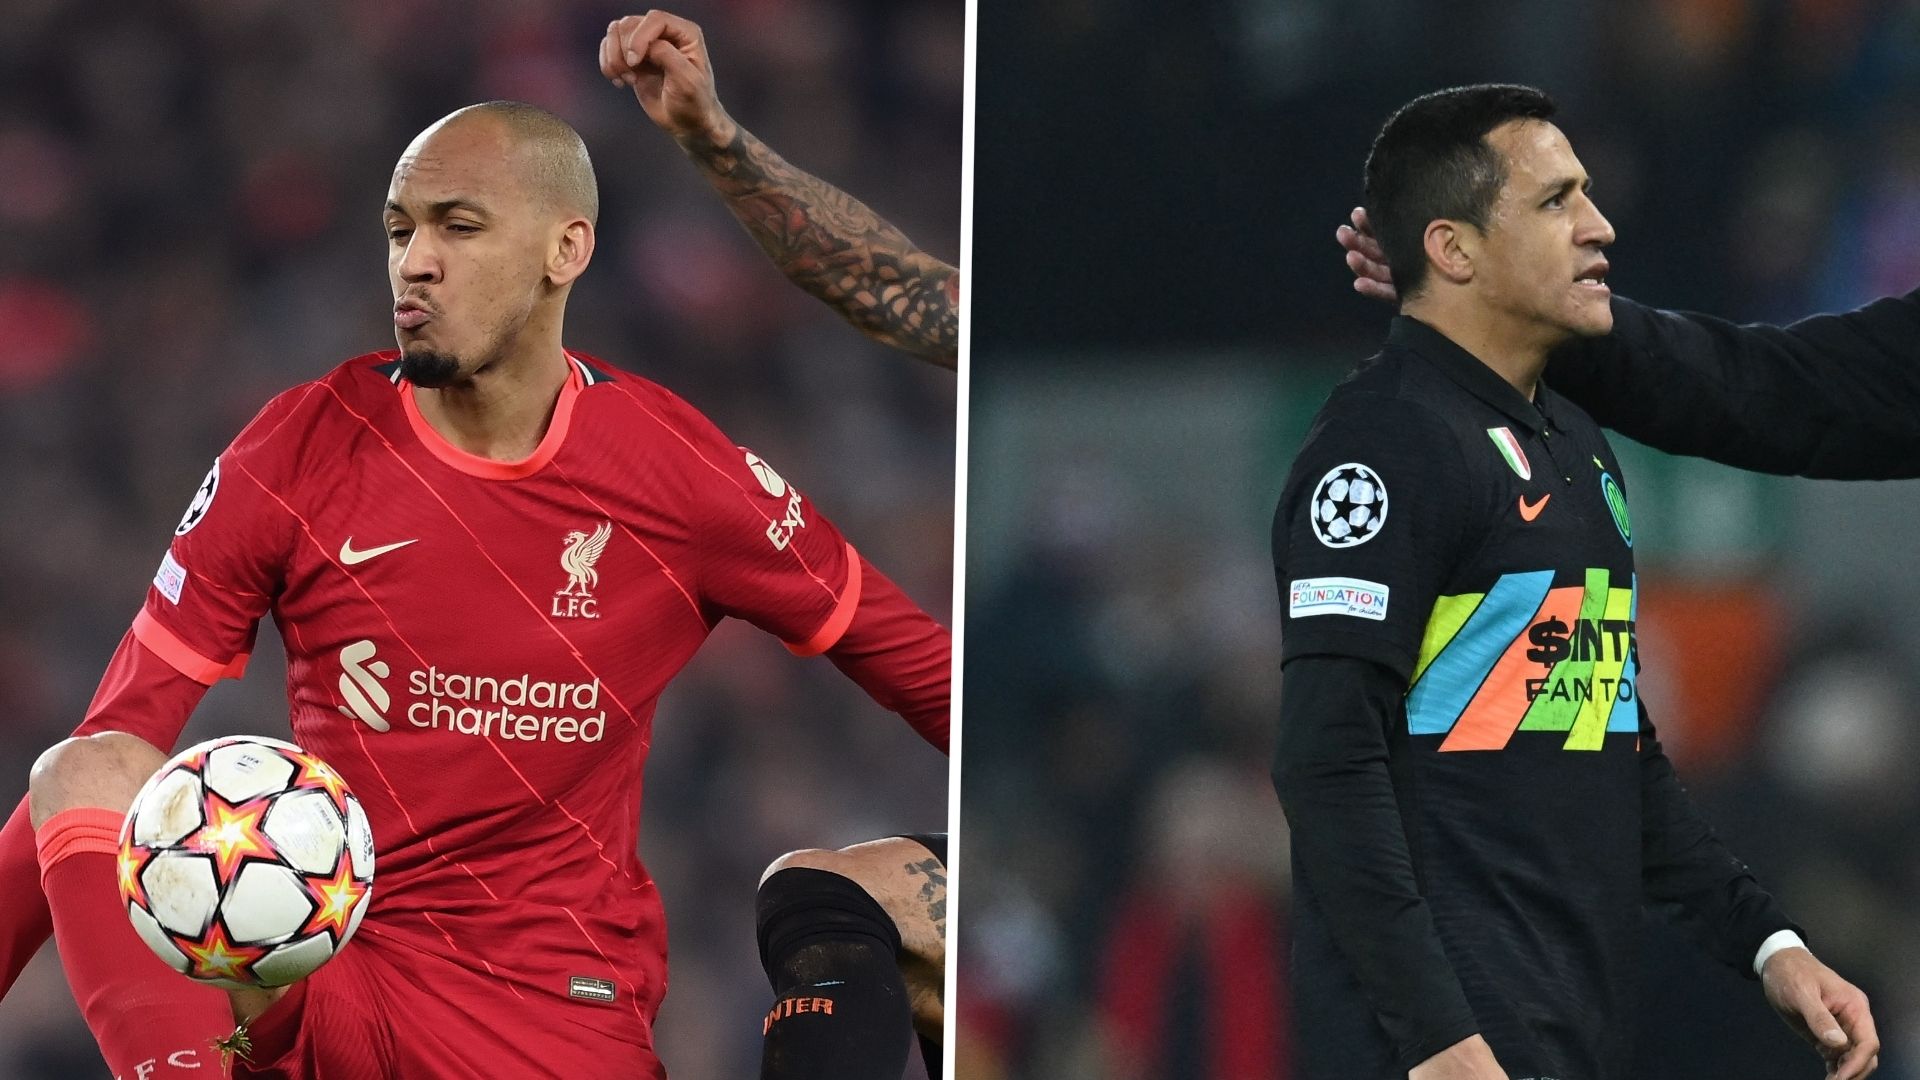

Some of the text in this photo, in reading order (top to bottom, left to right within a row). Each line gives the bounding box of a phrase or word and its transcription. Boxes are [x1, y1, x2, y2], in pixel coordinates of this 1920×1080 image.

[551, 597, 600, 619] L.F.C.
[408, 665, 600, 710] standard
[1525, 678, 1637, 702] FAN TO
[407, 697, 606, 743] chartered
[763, 997, 834, 1036] INTER
